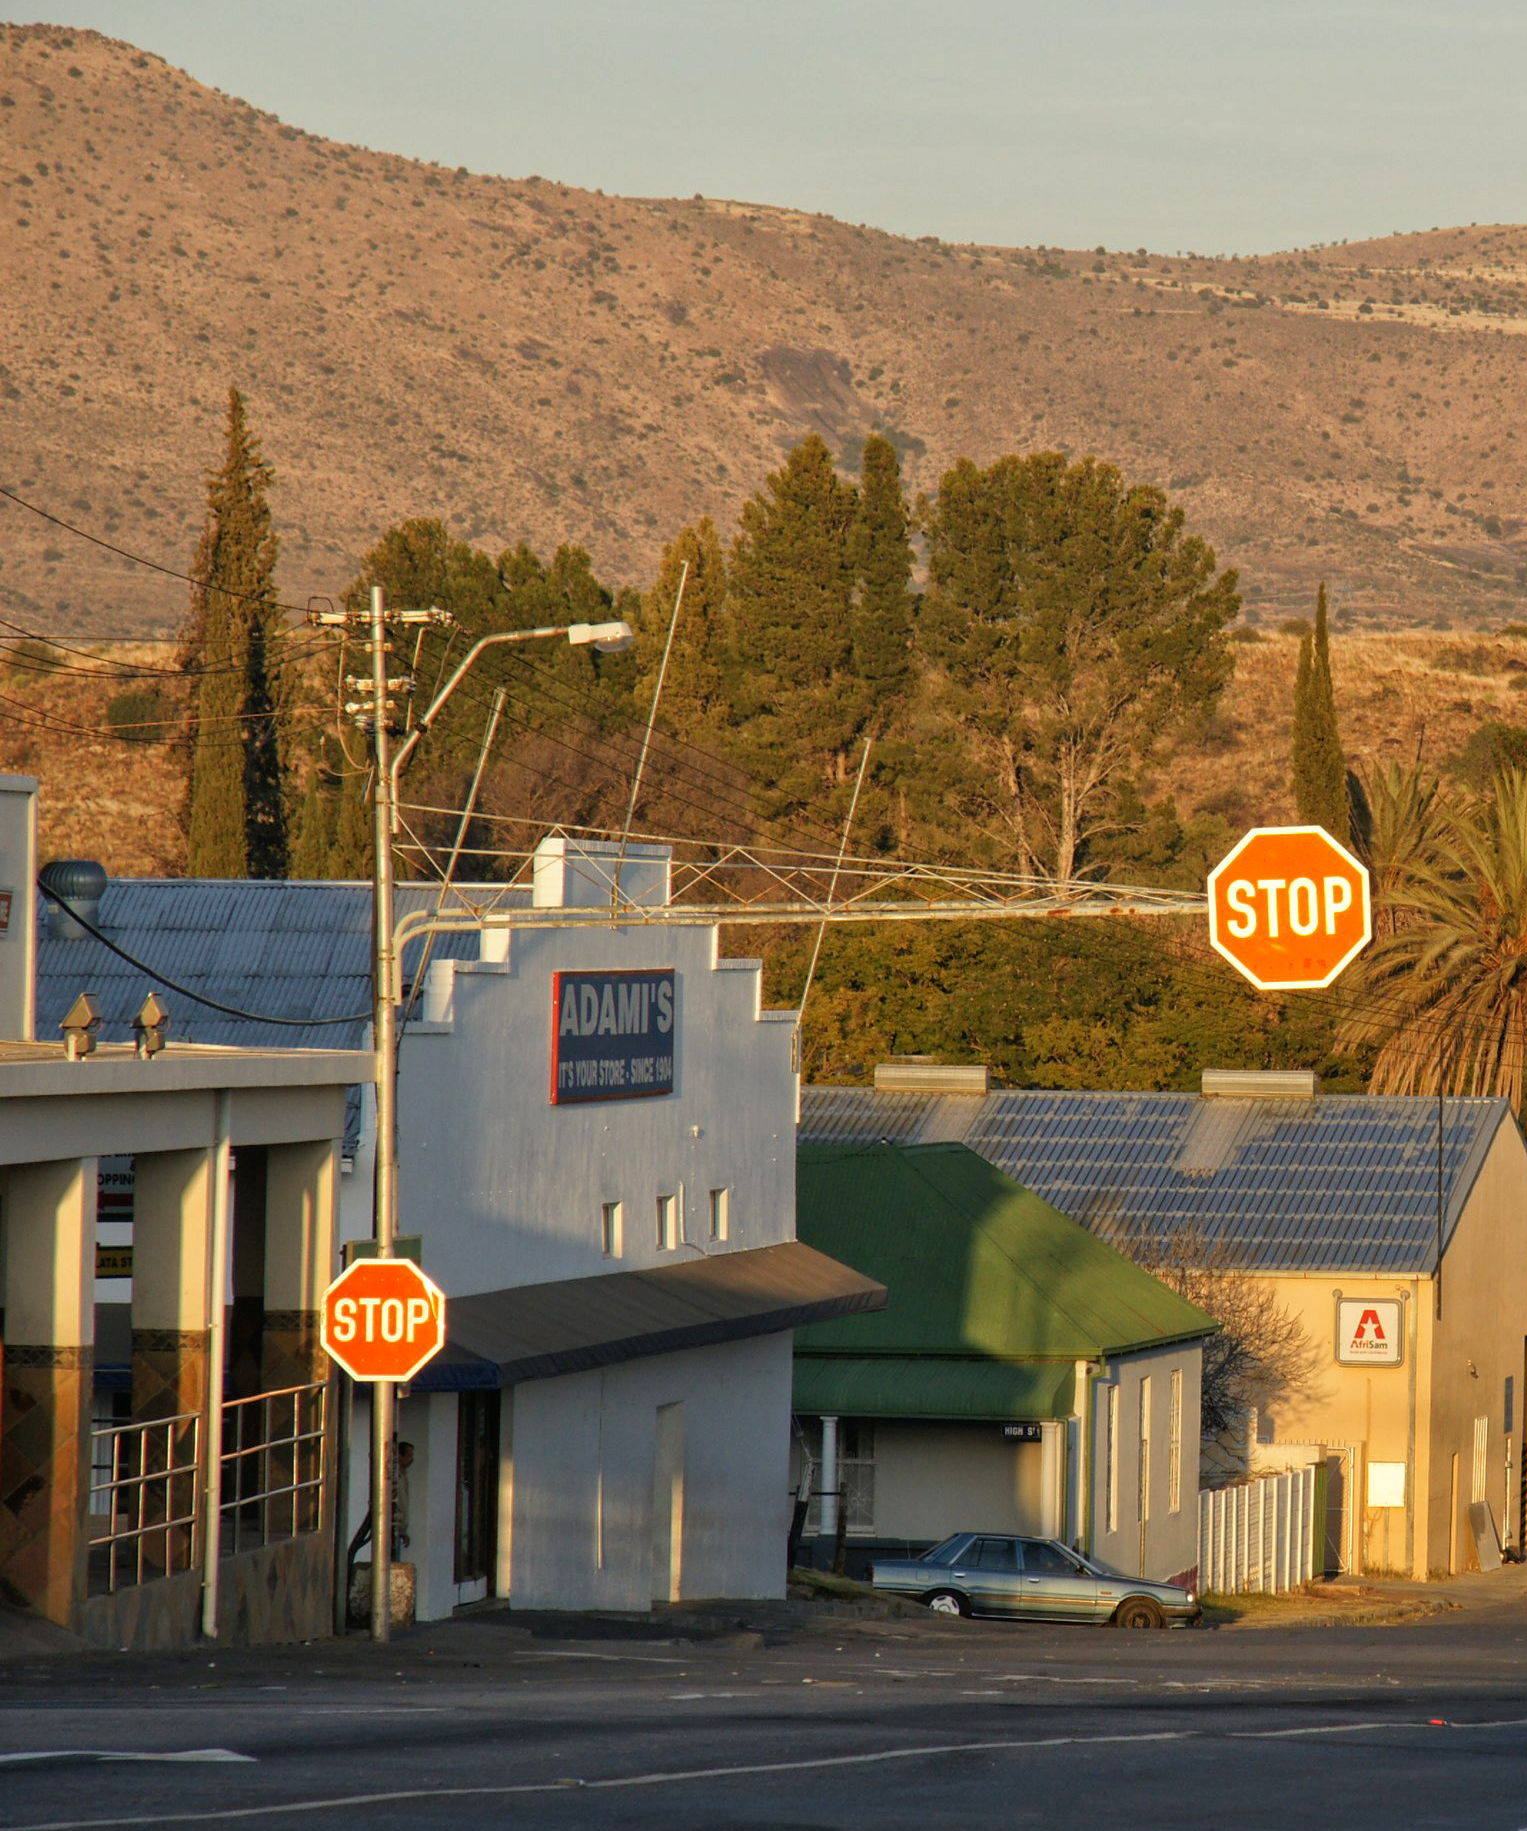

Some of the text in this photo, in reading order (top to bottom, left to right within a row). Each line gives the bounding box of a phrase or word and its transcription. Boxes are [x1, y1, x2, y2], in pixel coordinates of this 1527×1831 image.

[1227, 876, 1352, 938] STOP
[560, 980, 673, 1036] ADAMI'S
[559, 1061, 574, 1088] IT'S
[575, 1060, 598, 1087] YOUR
[599, 1059, 625, 1086] STORE
[631, 1057, 654, 1084] SINCE
[333, 1298, 430, 1342] STOP
[1350, 1340, 1388, 1349] AfriSam
[1004, 1426, 1024, 1436] HIGH
